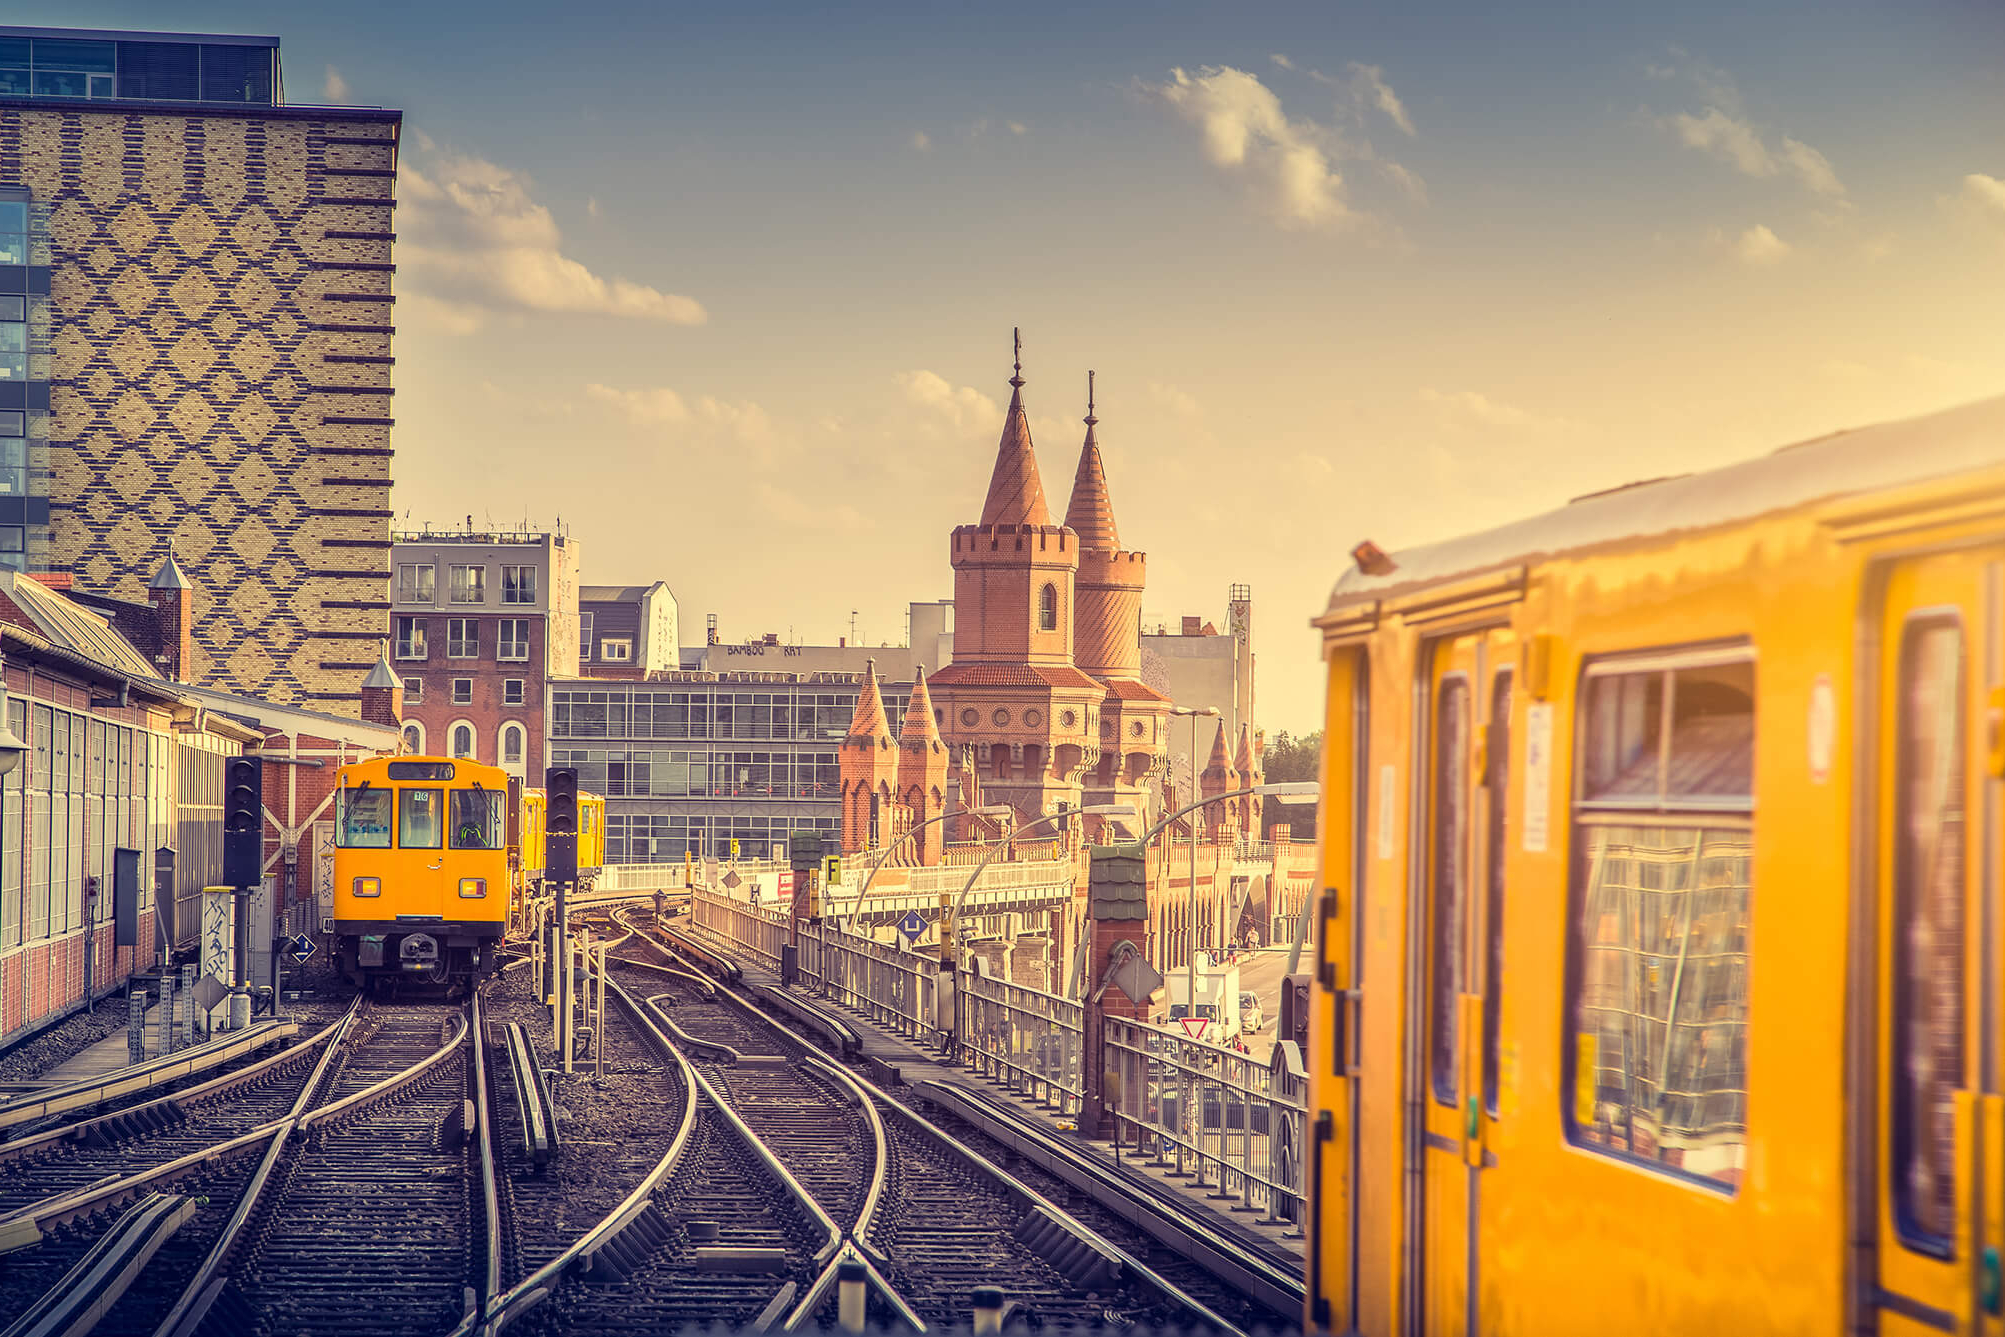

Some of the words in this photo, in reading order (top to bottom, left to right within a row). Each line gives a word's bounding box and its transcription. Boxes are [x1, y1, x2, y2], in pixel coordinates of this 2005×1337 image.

[727, 645, 765, 656] BAMBOO
[784, 646, 803, 656] RAT
[829, 859, 838, 881] F
